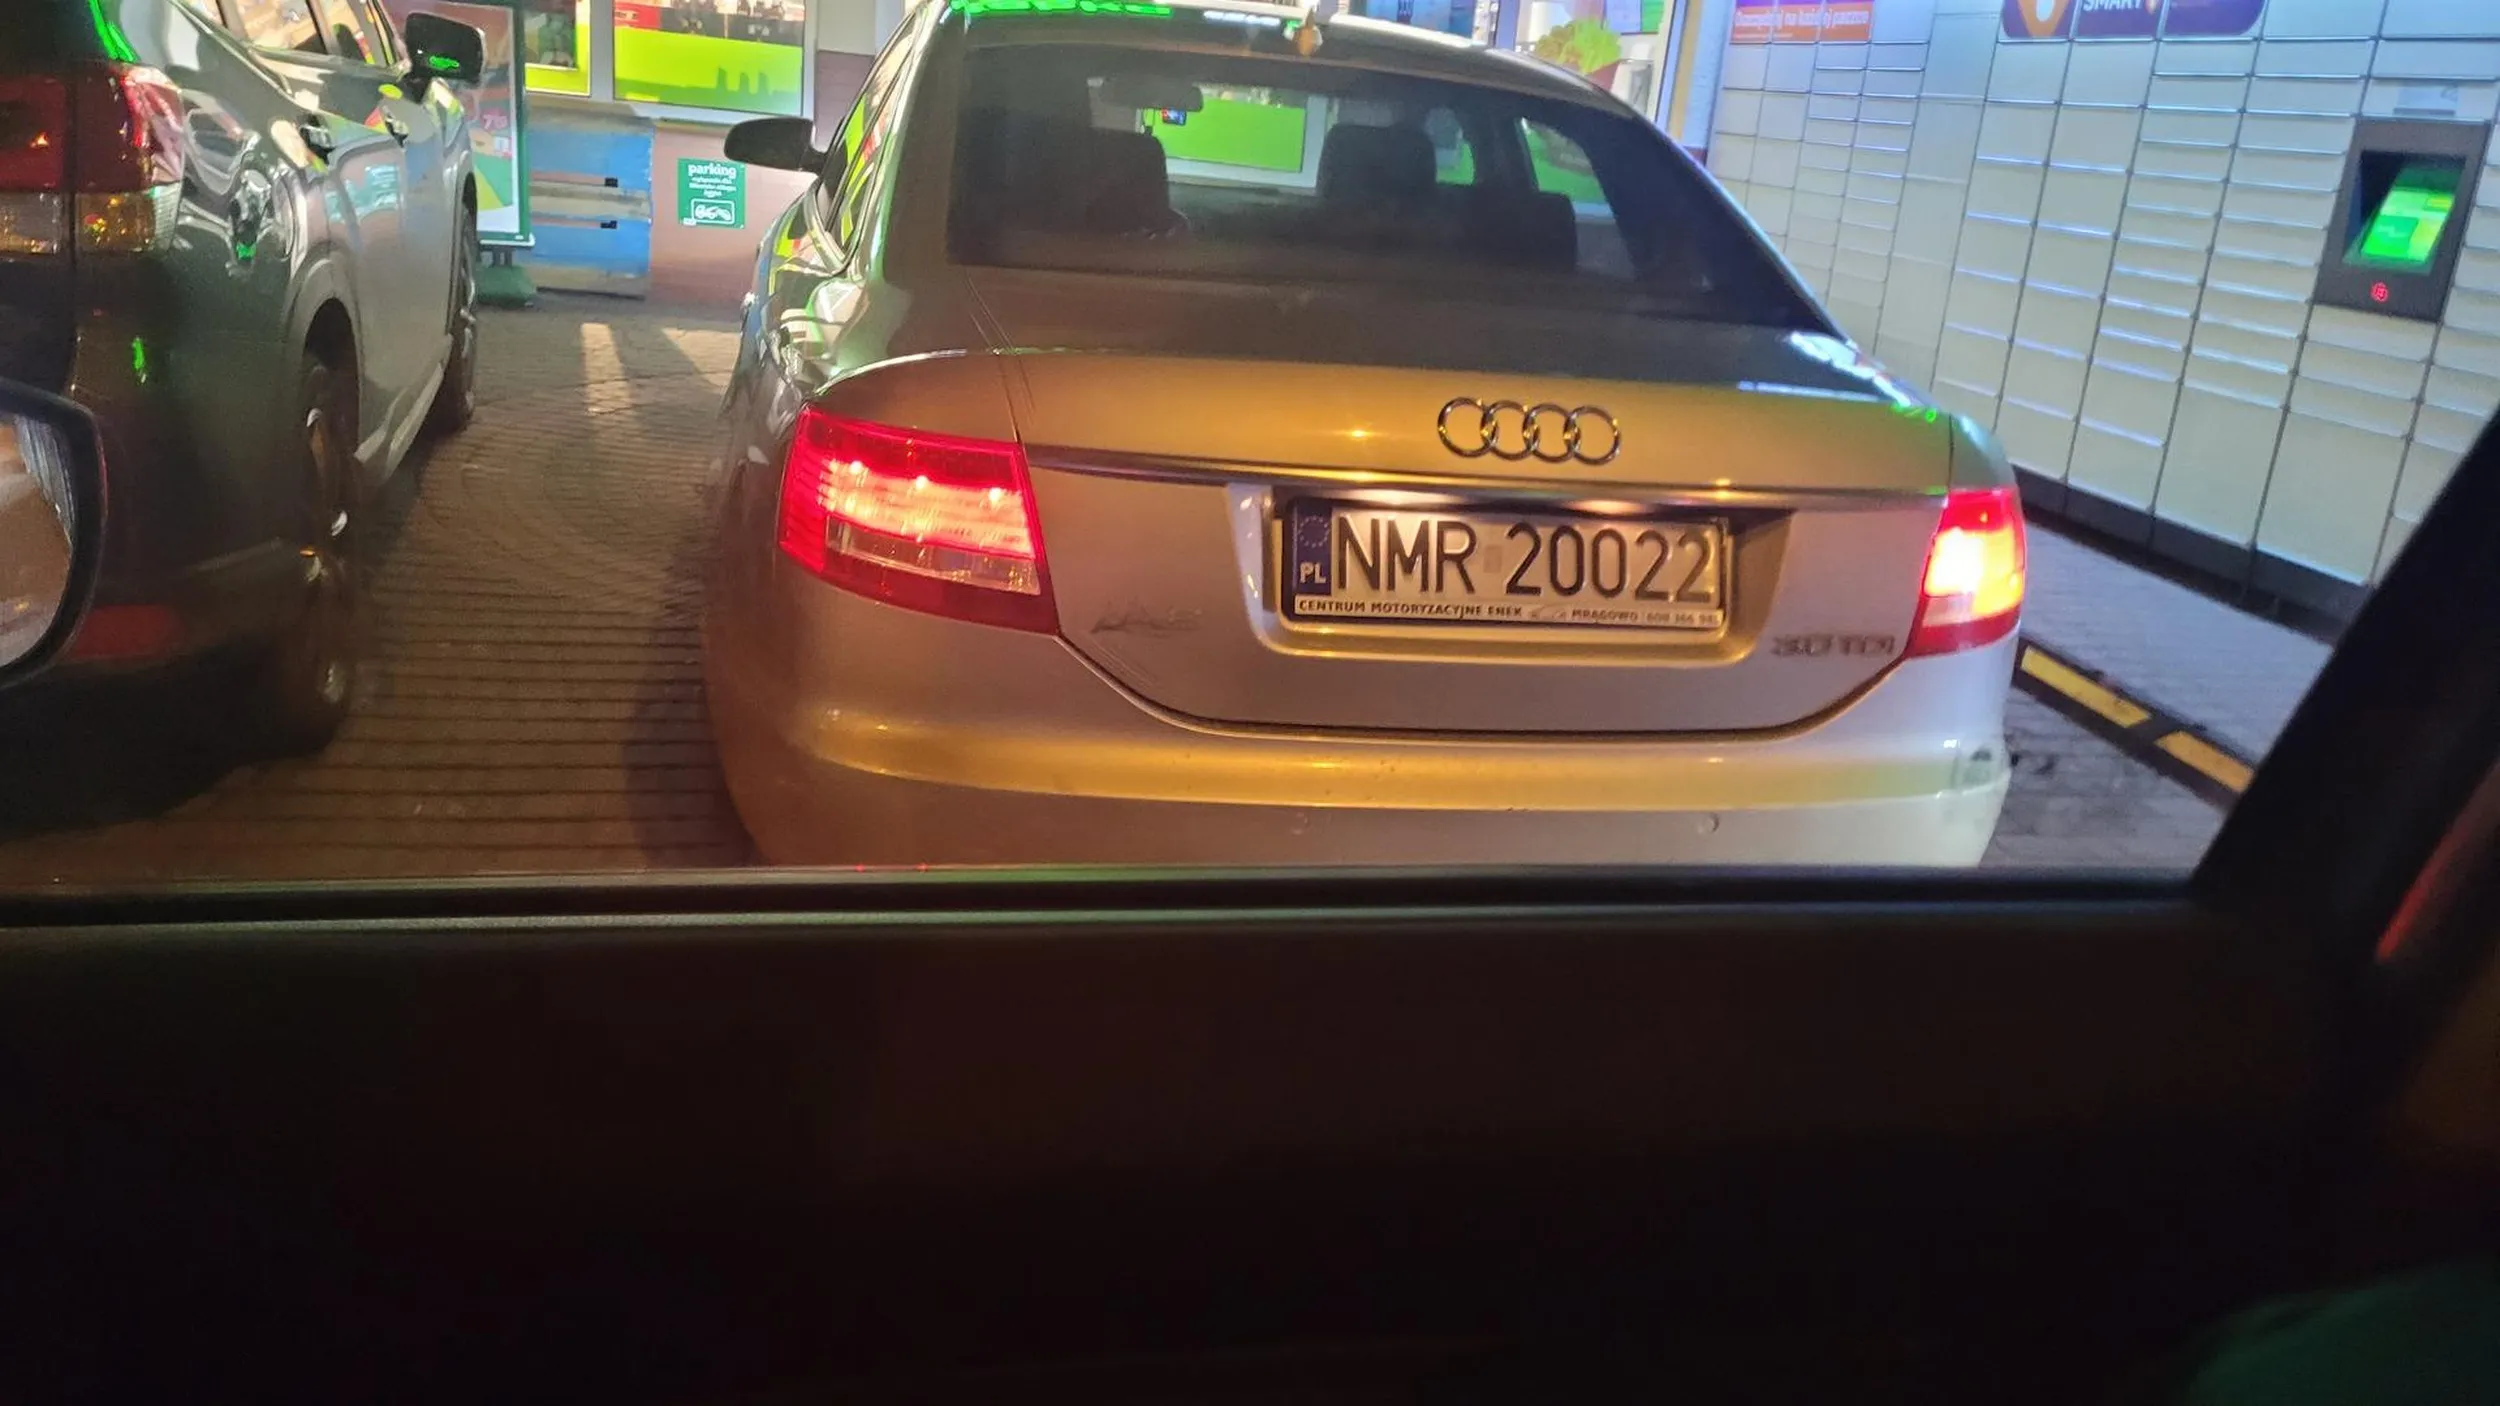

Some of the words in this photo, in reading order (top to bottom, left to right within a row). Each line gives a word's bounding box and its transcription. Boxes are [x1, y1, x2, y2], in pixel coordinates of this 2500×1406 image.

[687, 162, 737, 180] parking
[1338, 515, 1476, 594] NMR
[1506, 522, 1711, 602] 20022
[1300, 561, 1327, 584] PL
[1299, 600, 1365, 613] CENTRUM
[1371, 602, 1480, 619] MOTORYZACYJNE
